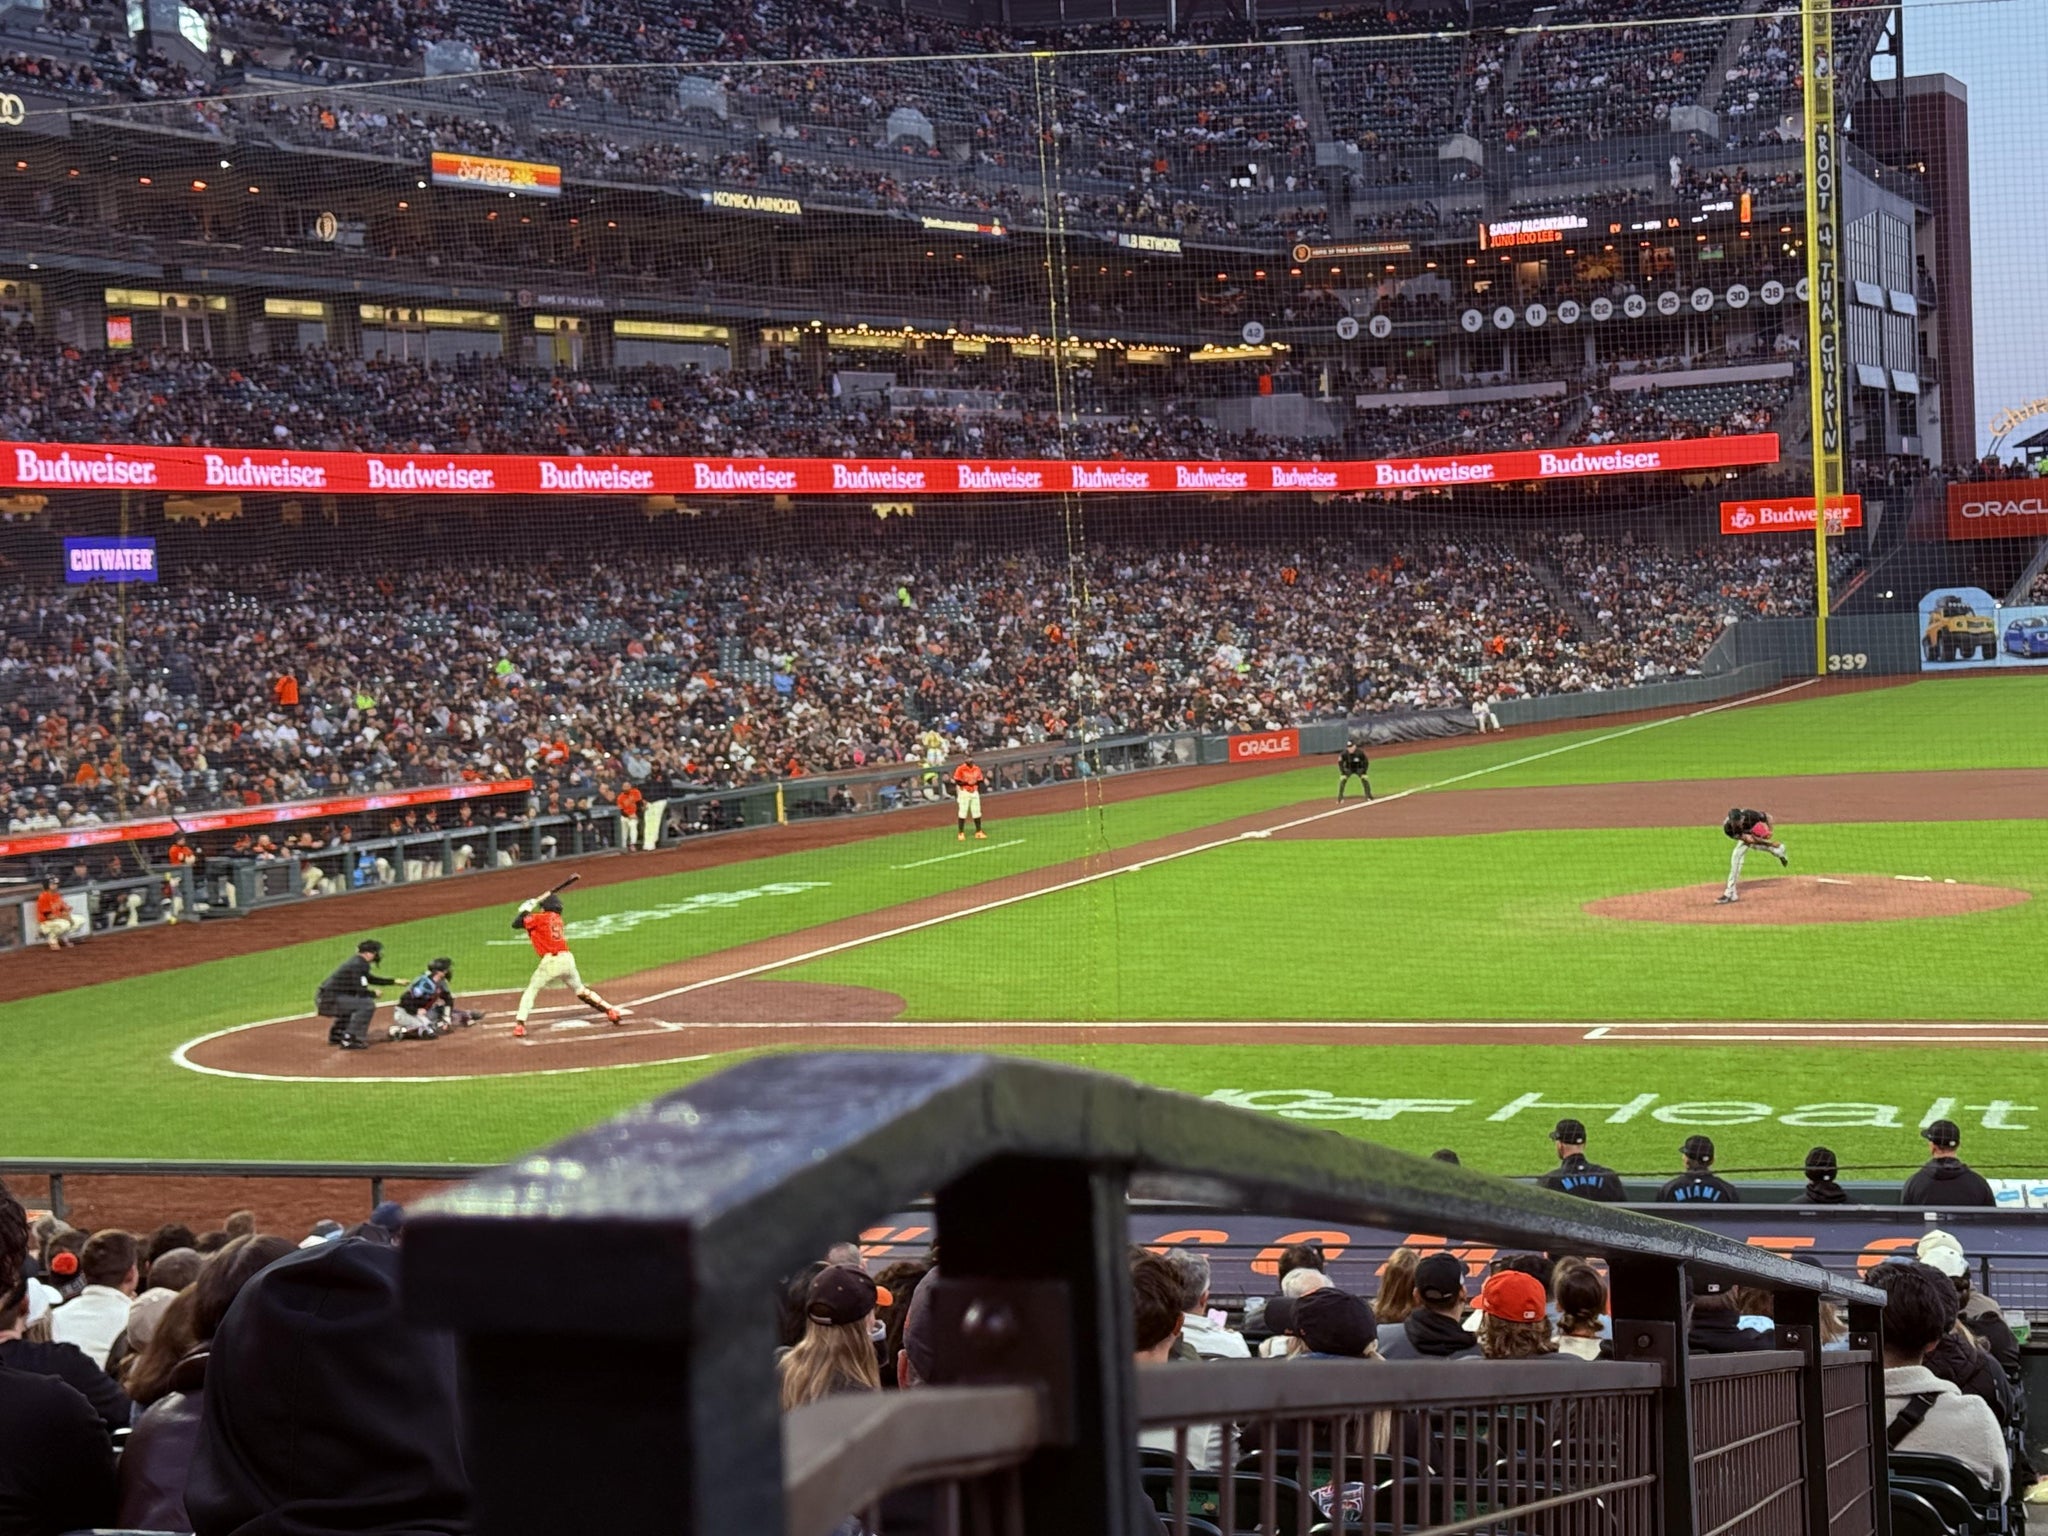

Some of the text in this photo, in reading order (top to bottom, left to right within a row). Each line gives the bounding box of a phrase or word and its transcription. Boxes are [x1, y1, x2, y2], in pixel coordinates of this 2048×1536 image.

[713, 191, 802, 215] KONICA MINOLTA
[1489, 221, 1522, 237] SANDY
[1521, 215, 1578, 233] ALCANTARA
[1138, 234, 1181, 253] NETWORK
[1490, 233, 1516, 248] JUNG
[1516, 232, 1537, 245] HOO
[1537, 230, 1554, 243] LEE
[1818, 226, 1832, 246] 4
[1695, 294, 1710, 306] 27
[1730, 290, 1746, 302] 30
[1765, 287, 1780, 299] 38
[1820, 262, 1834, 321] THA
[1594, 304, 1609, 315] 22
[1628, 301, 1643, 312] 24
[1661, 297, 1676, 309] 25
[1468, 315, 1476, 326] 3
[1499, 312, 1507, 323] 4
[1531, 310, 1541, 320] 11
[1561, 307, 1576, 318] 20
[1246, 328, 1261, 339] 42
[1820, 334, 1837, 449] CHIKIN
[15, 448, 1660, 490] Budweiser Budweiser Budweiser Budweiser Budweiser Budweiser Budweiser Budweiser Budweiser Budweiser Budweiser Budweiser
[1760, 506, 1852, 525] Budweser
[1961, 499, 2048, 518] ORACL
[70, 548, 153, 572] CUTWATER
[1828, 653, 1867, 671] 339
[1238, 736, 1291, 757] ORACLE
[1203, 1088, 2039, 1130] CSF Healt
[1561, 1175, 1604, 1192] MIAMI
[1674, 1185, 1721, 1202] MIAMI
